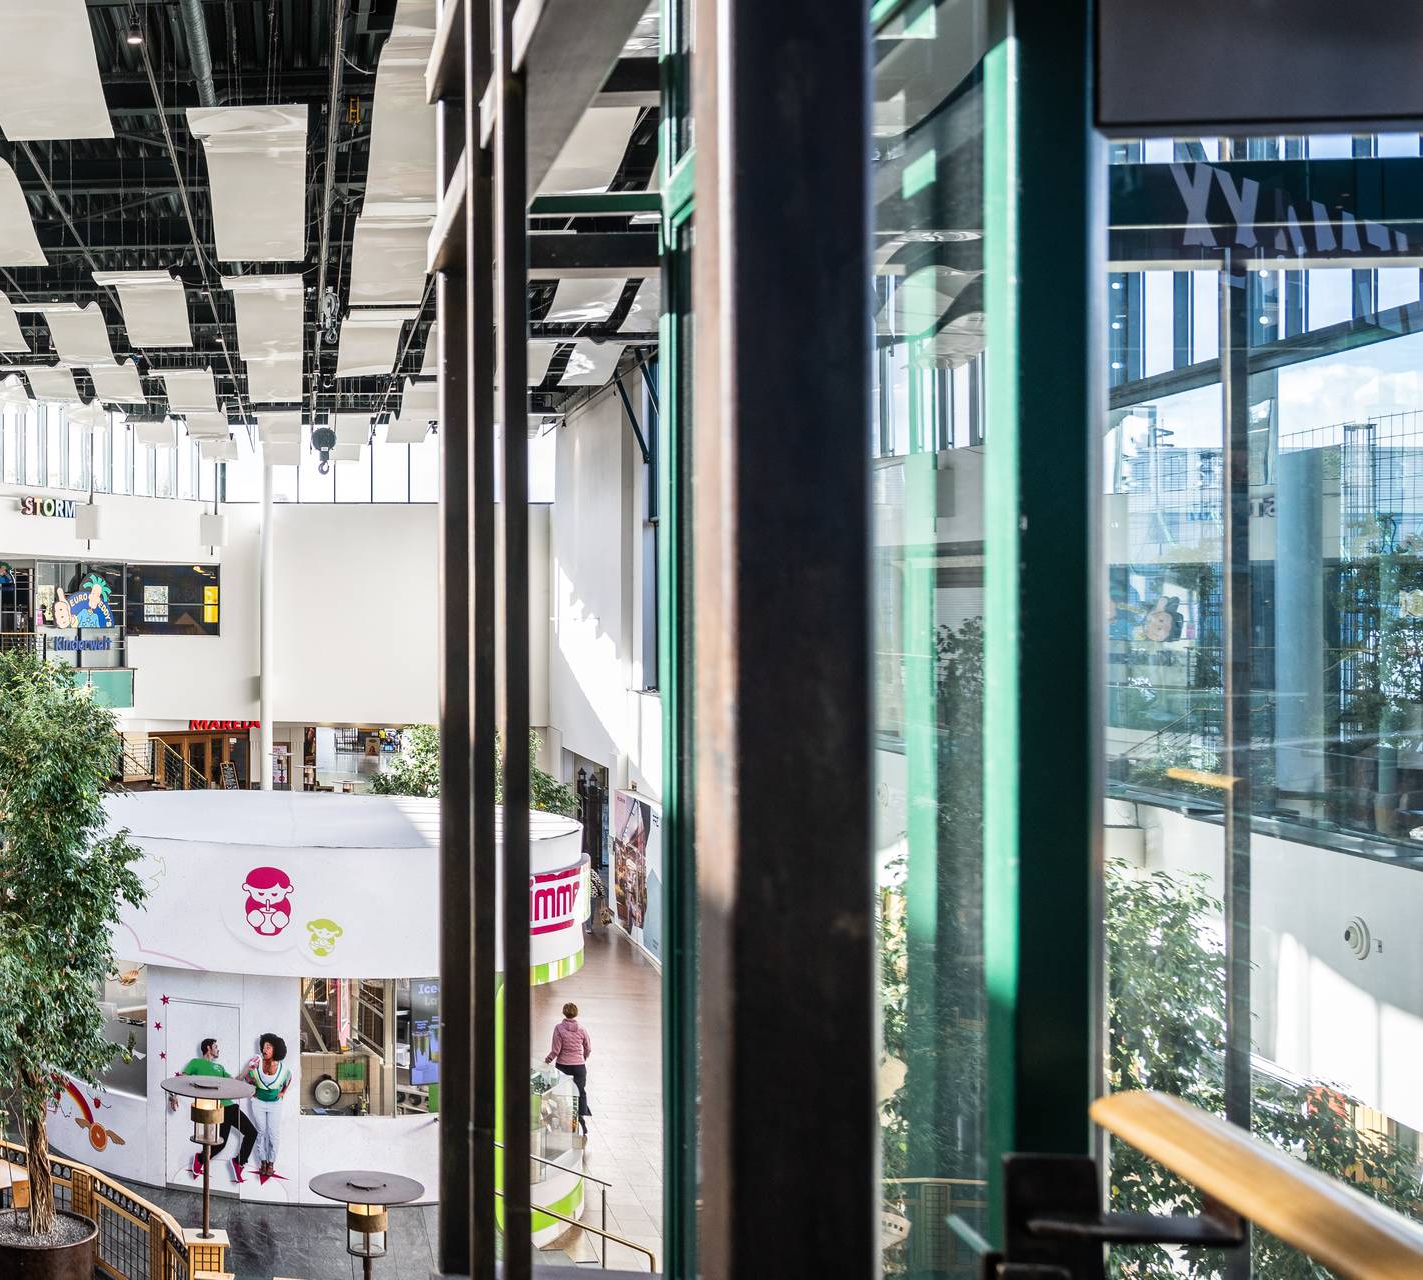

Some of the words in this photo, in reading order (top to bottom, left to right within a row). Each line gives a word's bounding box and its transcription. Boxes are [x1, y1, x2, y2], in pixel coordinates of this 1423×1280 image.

[23, 496, 77, 518] STORM
[69, 592, 88, 607] EURO
[53, 634, 113, 651] Kinderwelt
